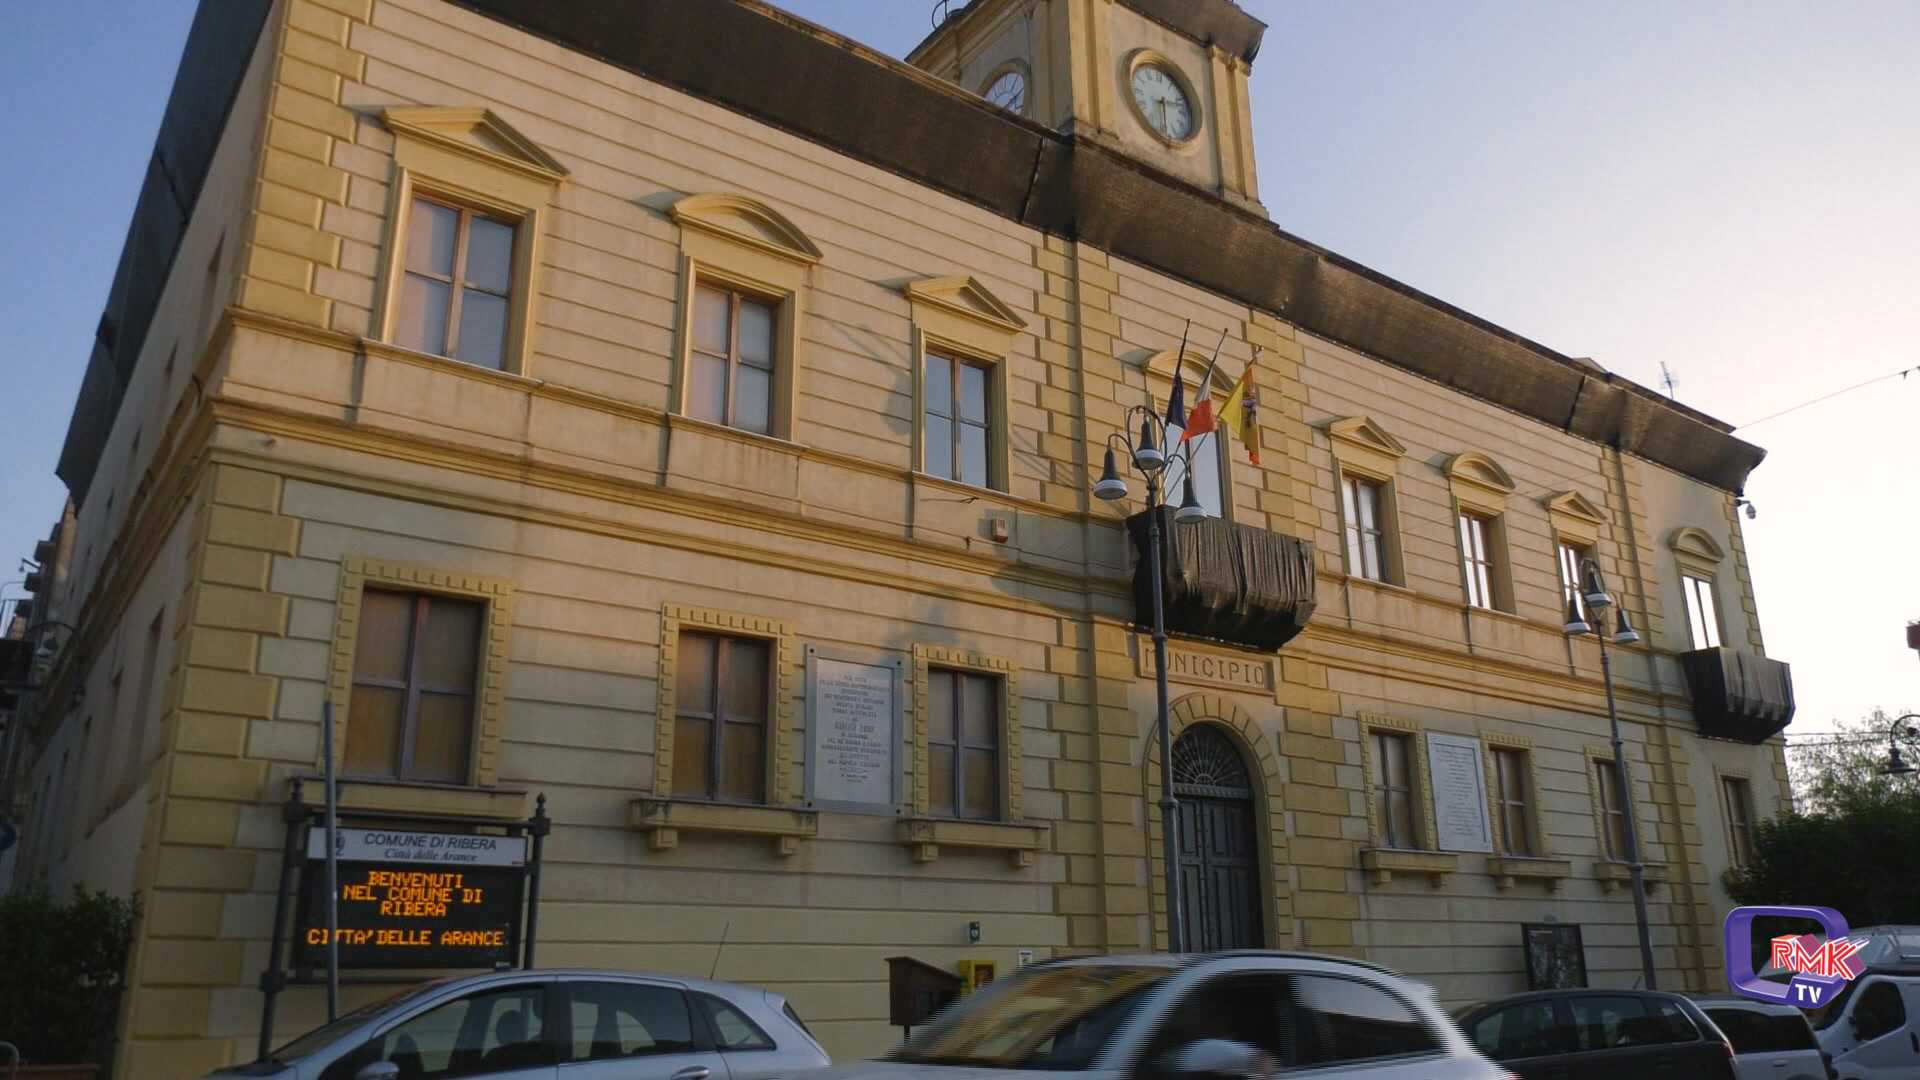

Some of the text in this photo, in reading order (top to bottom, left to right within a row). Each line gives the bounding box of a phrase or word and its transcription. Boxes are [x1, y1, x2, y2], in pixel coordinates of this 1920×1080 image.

[364, 833, 497, 850] COMUNE DI RIBERA
[441, 851, 478, 862] Arance
[368, 871, 464, 888] BENVENUTI
[343, 886, 483, 904] NEL COMUNE DI
[381, 901, 447, 916] RIBERA
[440, 931, 505, 945] ARANCE
